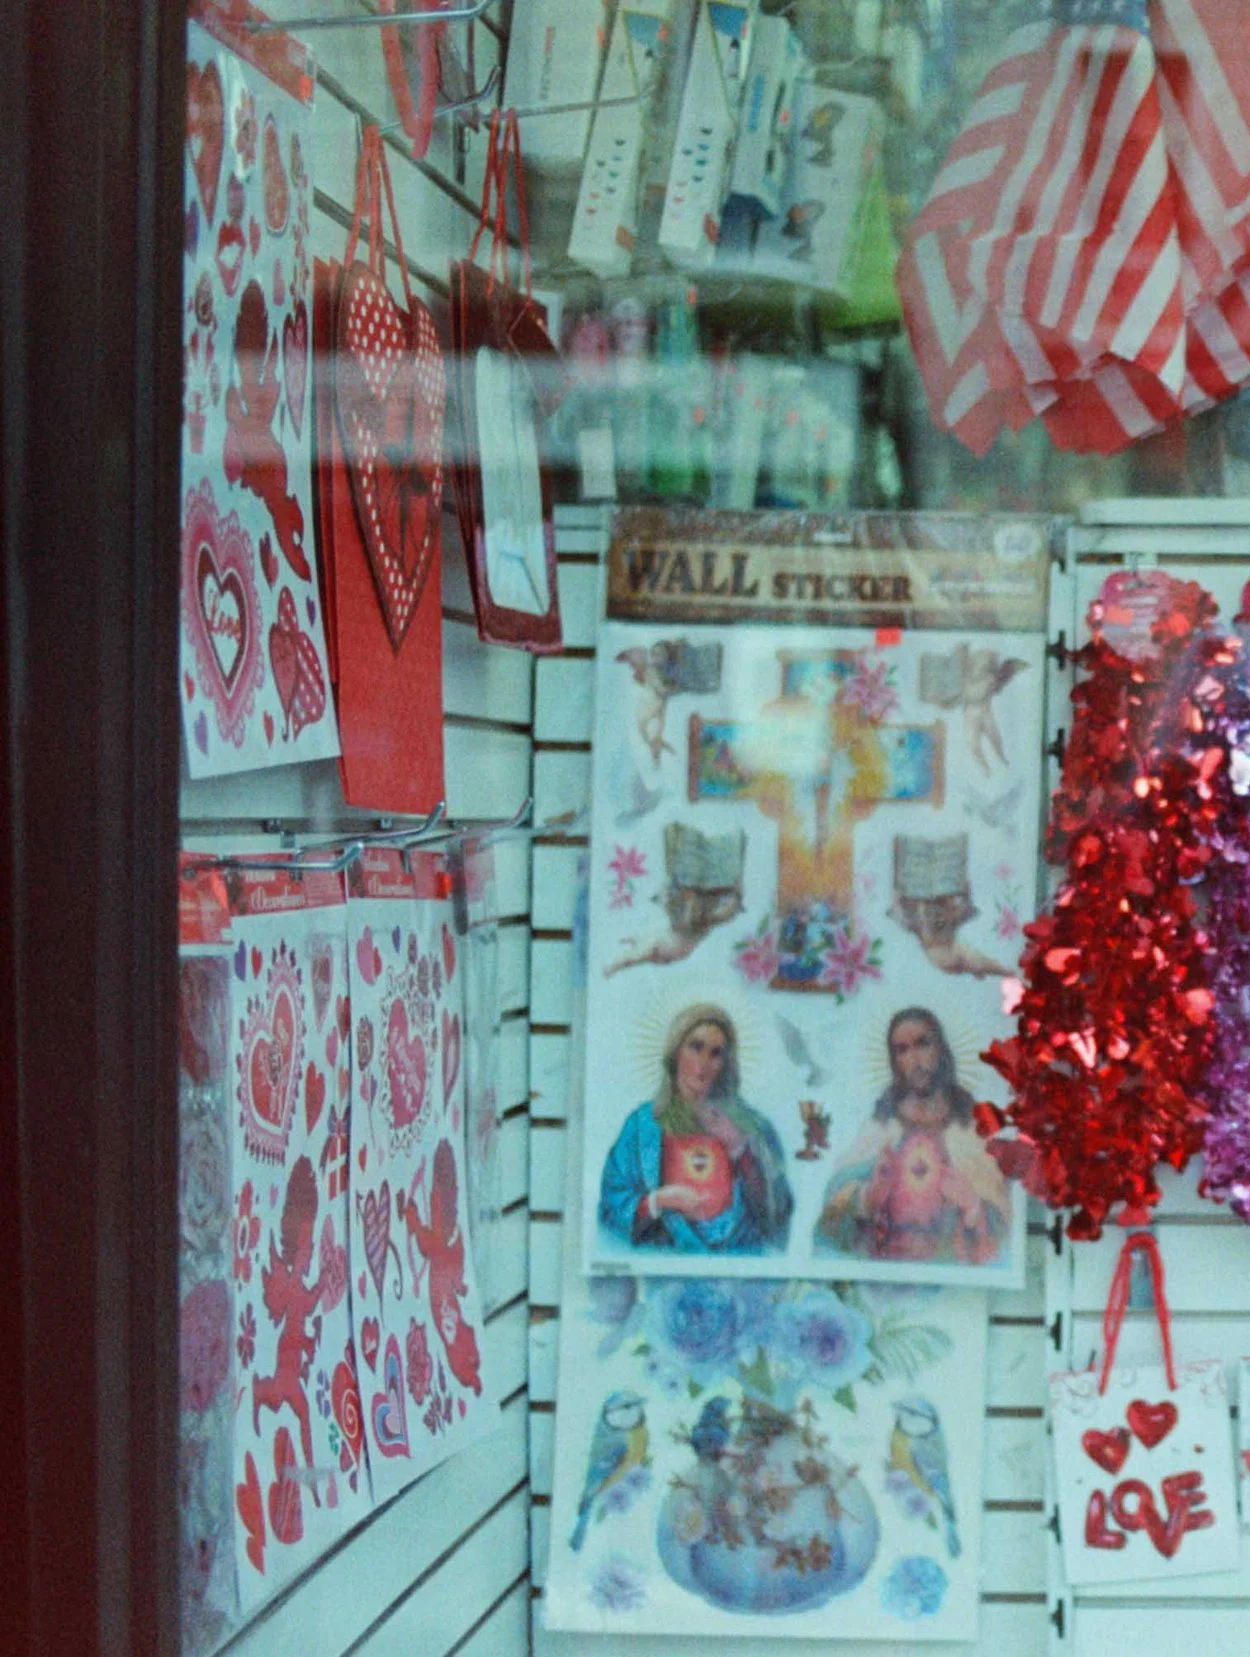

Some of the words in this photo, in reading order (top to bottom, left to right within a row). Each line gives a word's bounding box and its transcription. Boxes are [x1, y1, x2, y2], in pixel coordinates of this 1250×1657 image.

[622, 548, 760, 598] WALL
[771, 570, 913, 603] STICKER
[1085, 1470, 1216, 1560] LOVE
